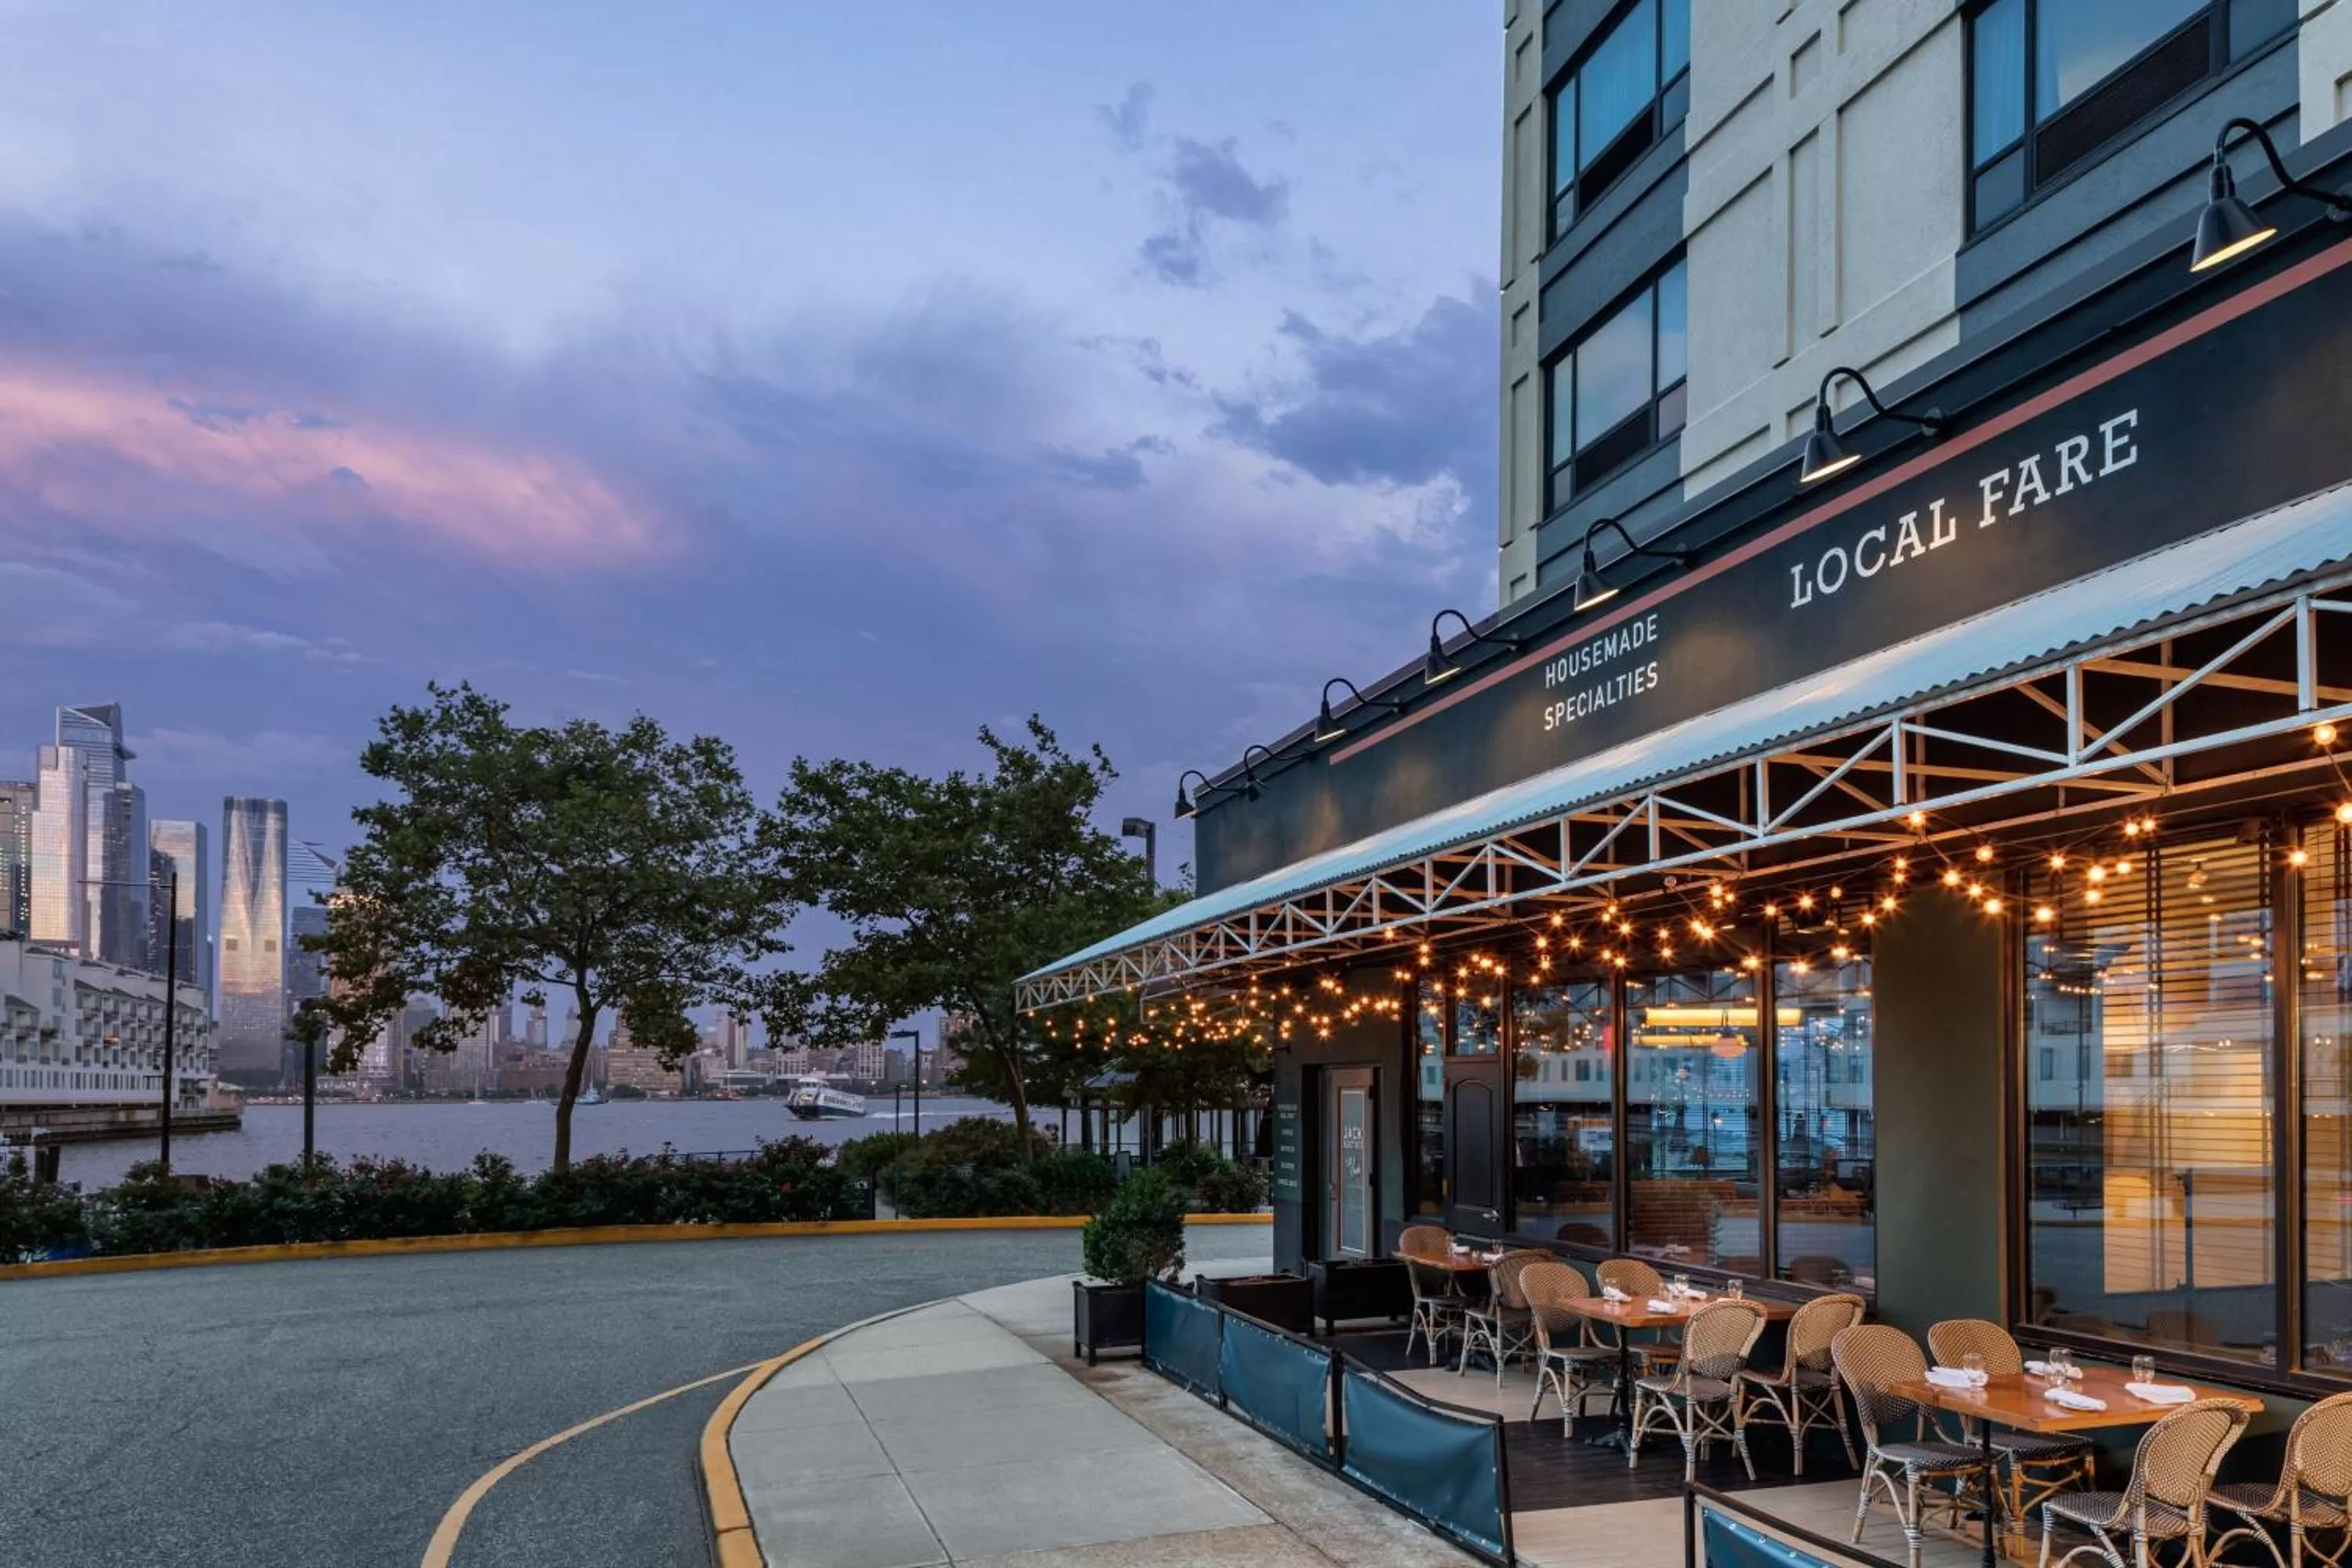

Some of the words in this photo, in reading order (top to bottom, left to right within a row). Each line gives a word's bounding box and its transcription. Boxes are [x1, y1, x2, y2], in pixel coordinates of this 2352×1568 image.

[1791, 498, 1957, 609] LOCAL
[1978, 408, 2138, 529] FARE
[1545, 614, 1658, 688] HOUSEMADE
[1543, 660, 1659, 731] SPECIALTIES
